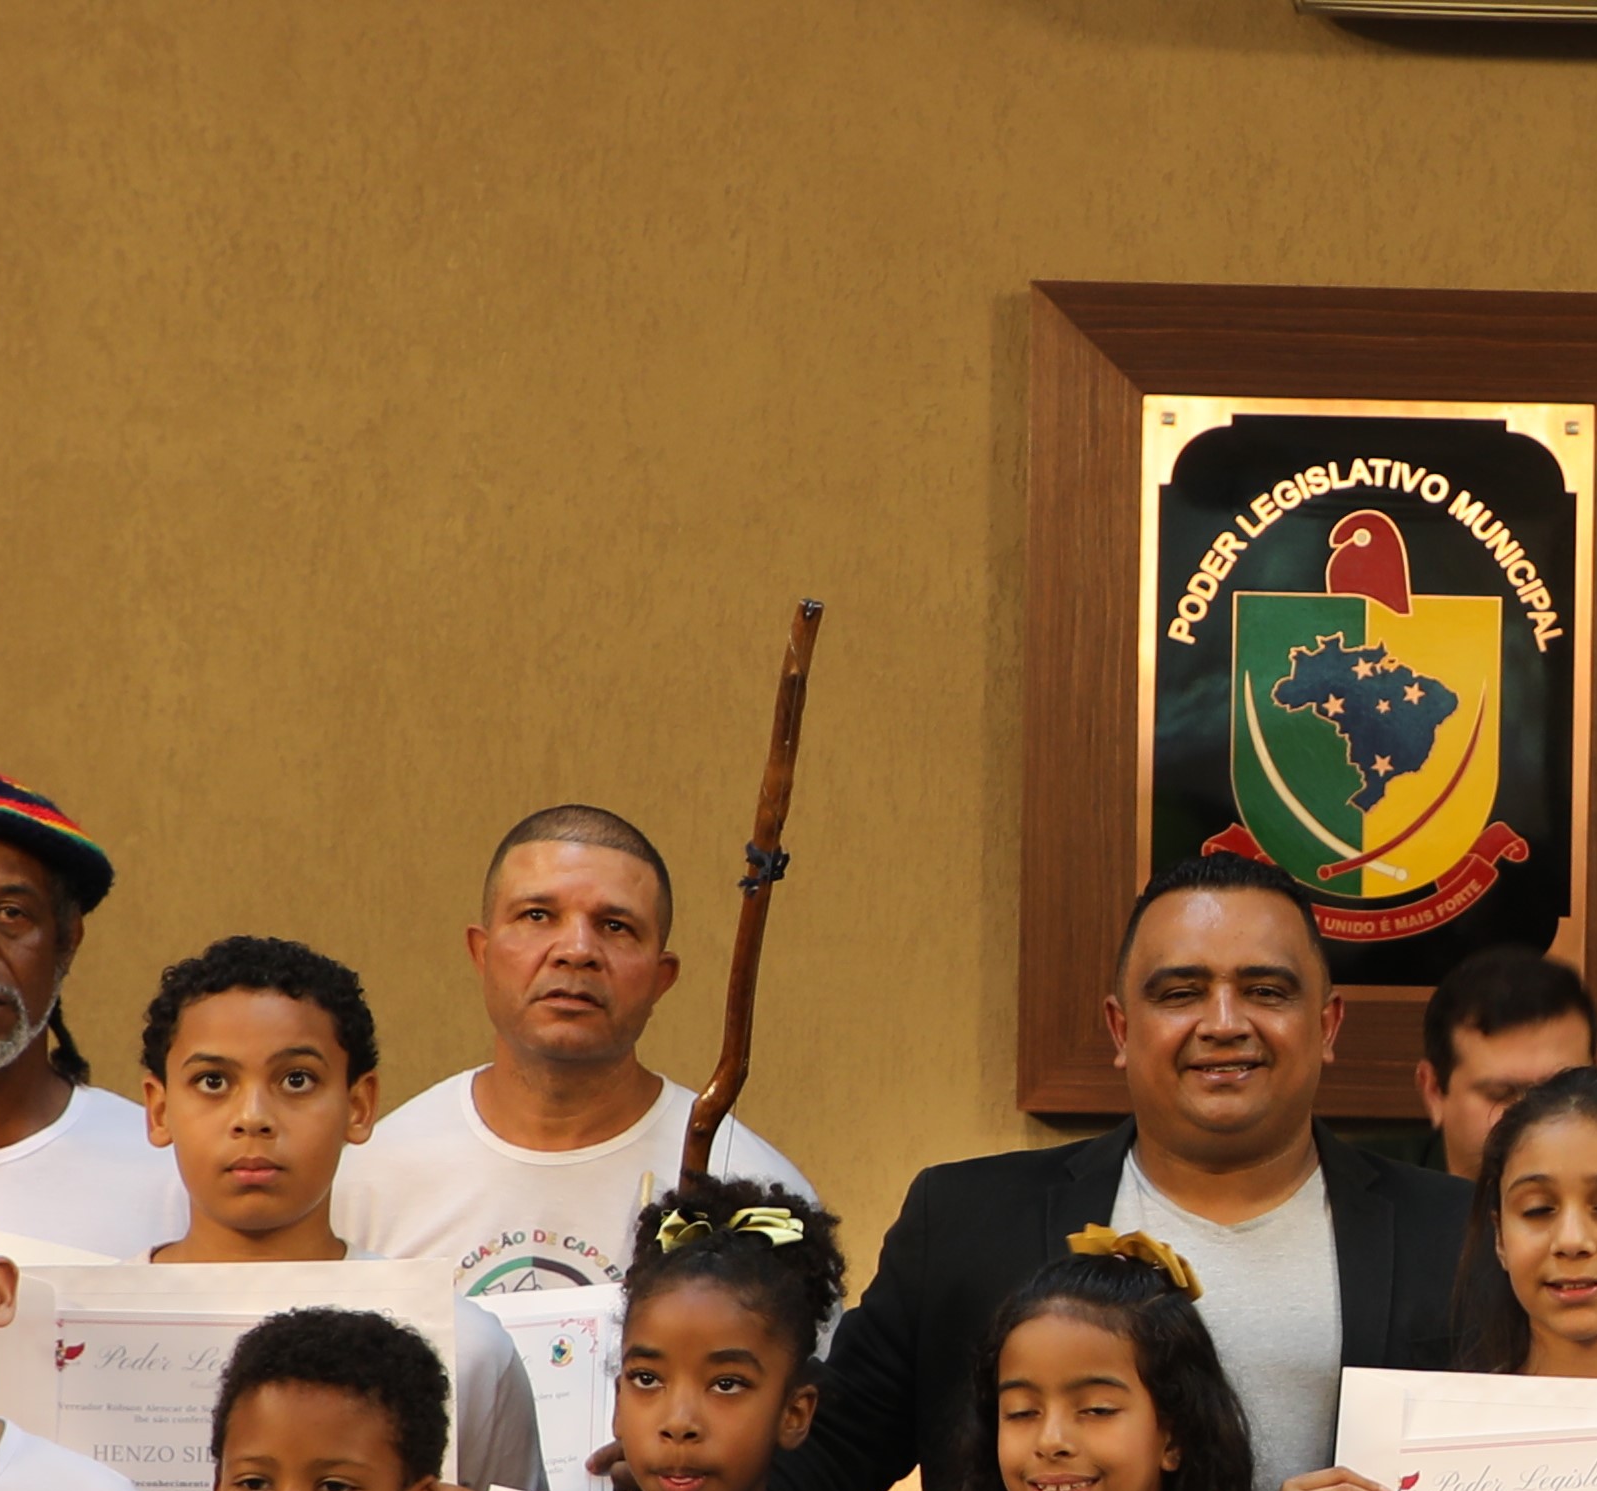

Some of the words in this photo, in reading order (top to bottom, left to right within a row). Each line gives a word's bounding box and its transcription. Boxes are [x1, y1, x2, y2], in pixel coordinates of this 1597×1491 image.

[1168, 531, 1247, 644] PODER
[1235, 457, 1450, 538] LEGISLATIVO
[1448, 490, 1564, 653] MUNICIPAL
[1324, 917, 1375, 933] UNIDO
[1380, 917, 1390, 932] É
[1394, 910, 1434, 930] MAIS
[1436, 878, 1482, 917] FORTE
[93, 1445, 175, 1463] HENZO
